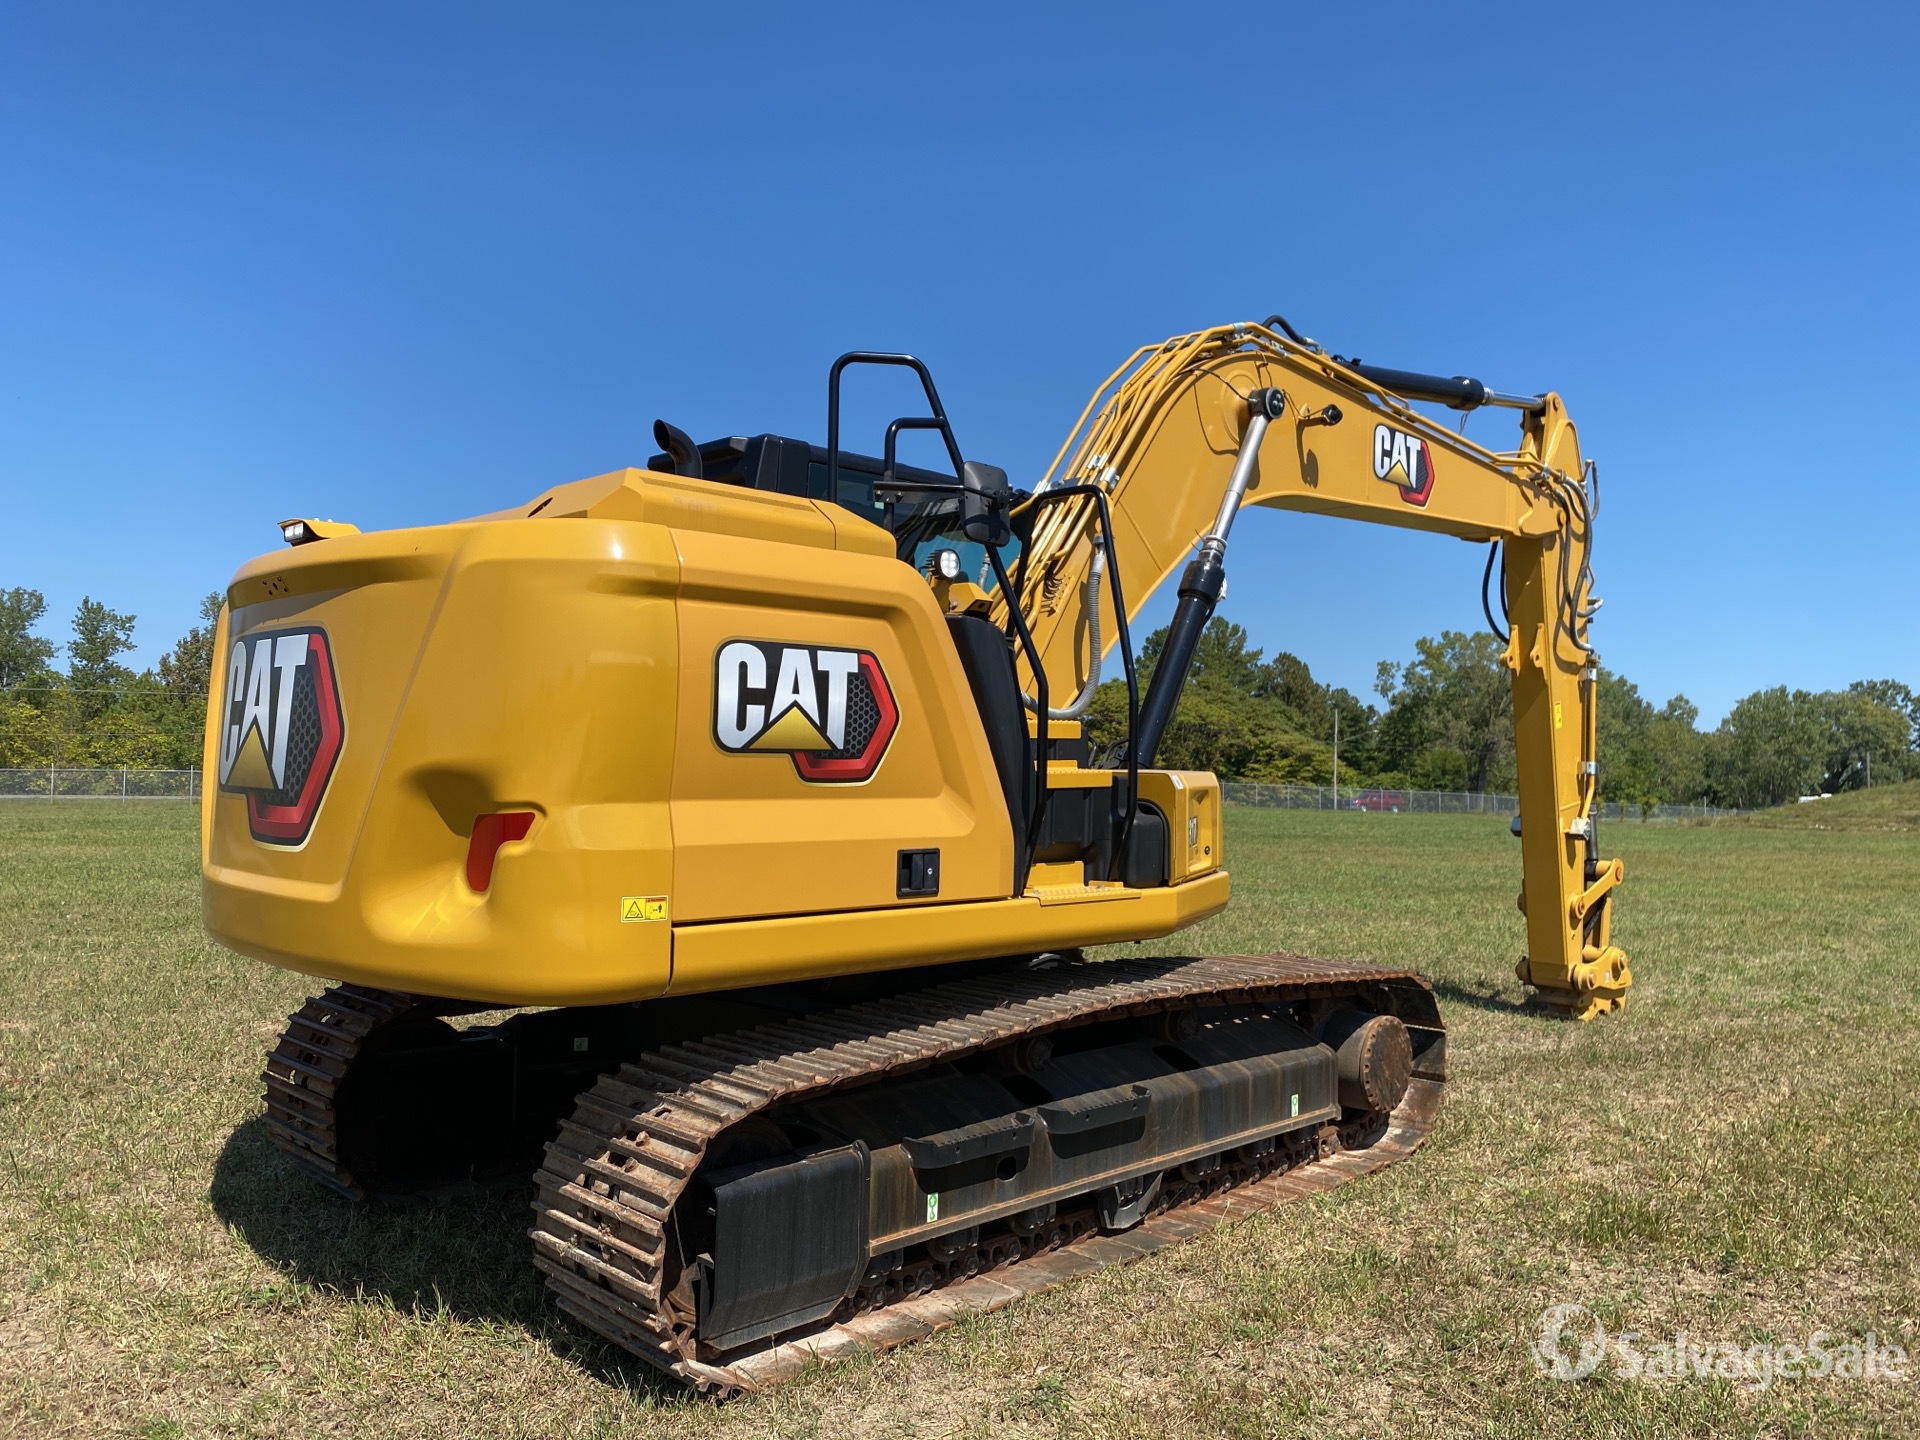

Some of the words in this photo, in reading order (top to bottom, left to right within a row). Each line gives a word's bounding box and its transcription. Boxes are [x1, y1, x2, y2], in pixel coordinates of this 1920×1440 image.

[1374, 425, 1421, 488] CAT
[220, 633, 309, 789] CAT
[718, 643, 859, 749] CAT
